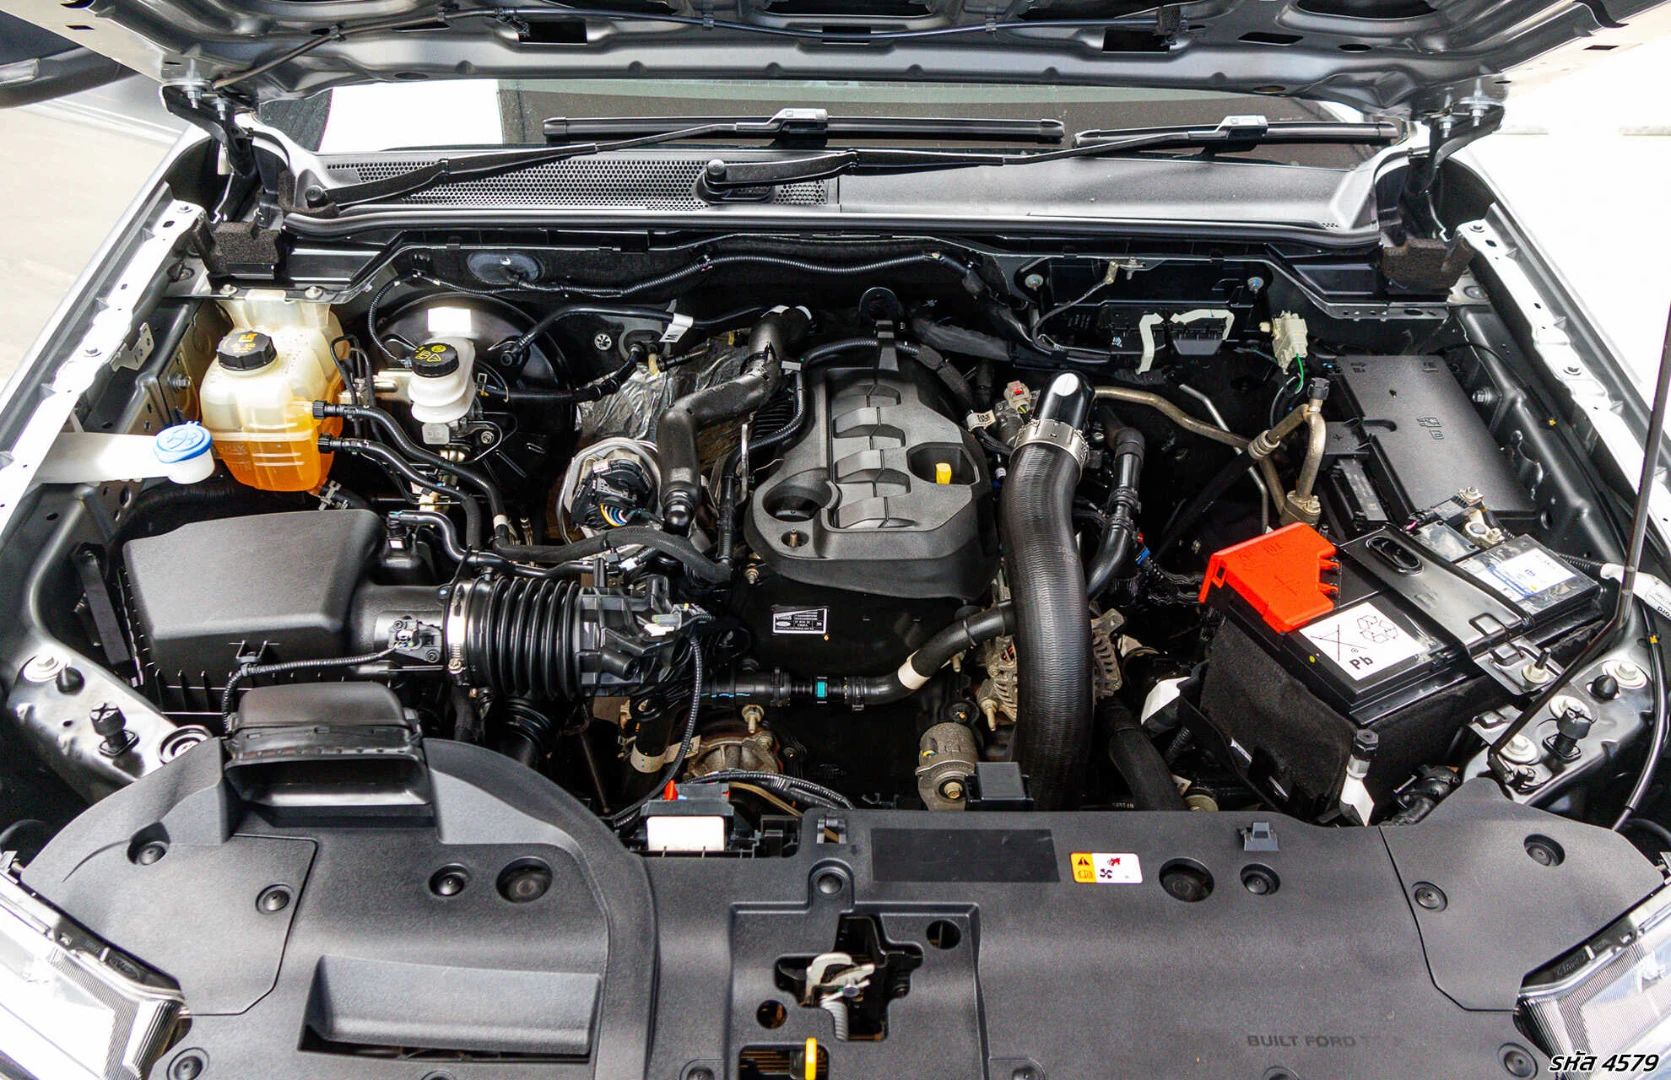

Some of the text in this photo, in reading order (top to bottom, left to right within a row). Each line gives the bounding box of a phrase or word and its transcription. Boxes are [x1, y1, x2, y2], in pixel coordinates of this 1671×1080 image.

[1349, 656, 1374, 670] Pb
[1247, 1035, 1299, 1048] BUILT
[1305, 1035, 1356, 1048] FORD
